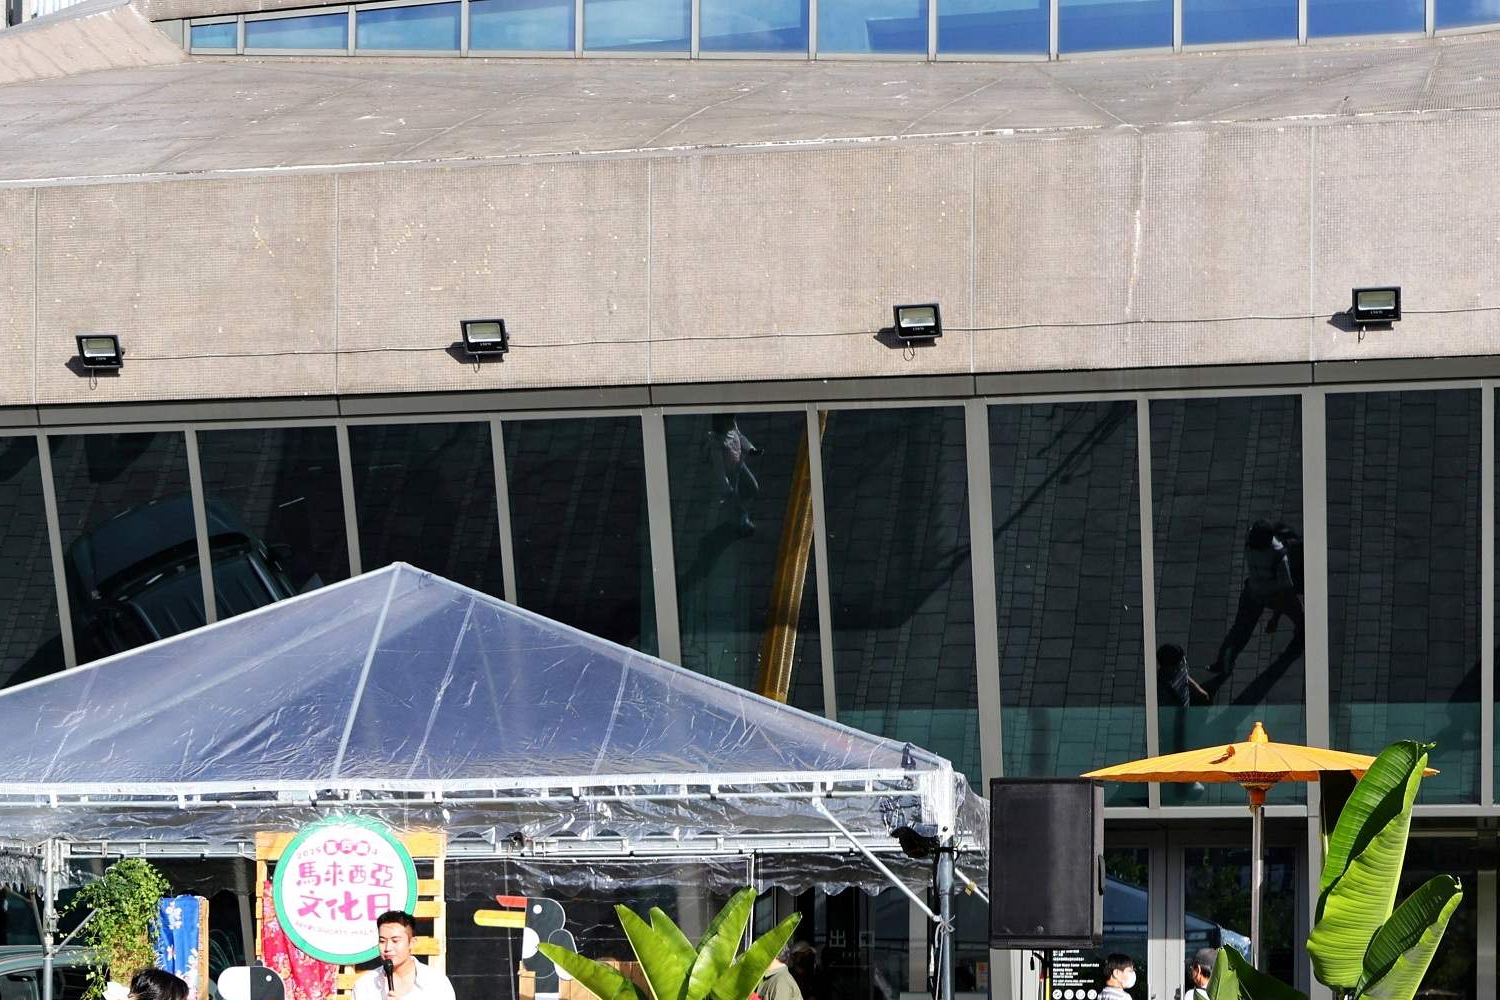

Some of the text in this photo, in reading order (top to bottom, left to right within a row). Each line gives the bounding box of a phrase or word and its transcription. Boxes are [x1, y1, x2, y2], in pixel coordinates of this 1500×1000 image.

[296, 861, 395, 889] 馬來西亞
[297, 890, 392, 922] 文化日
